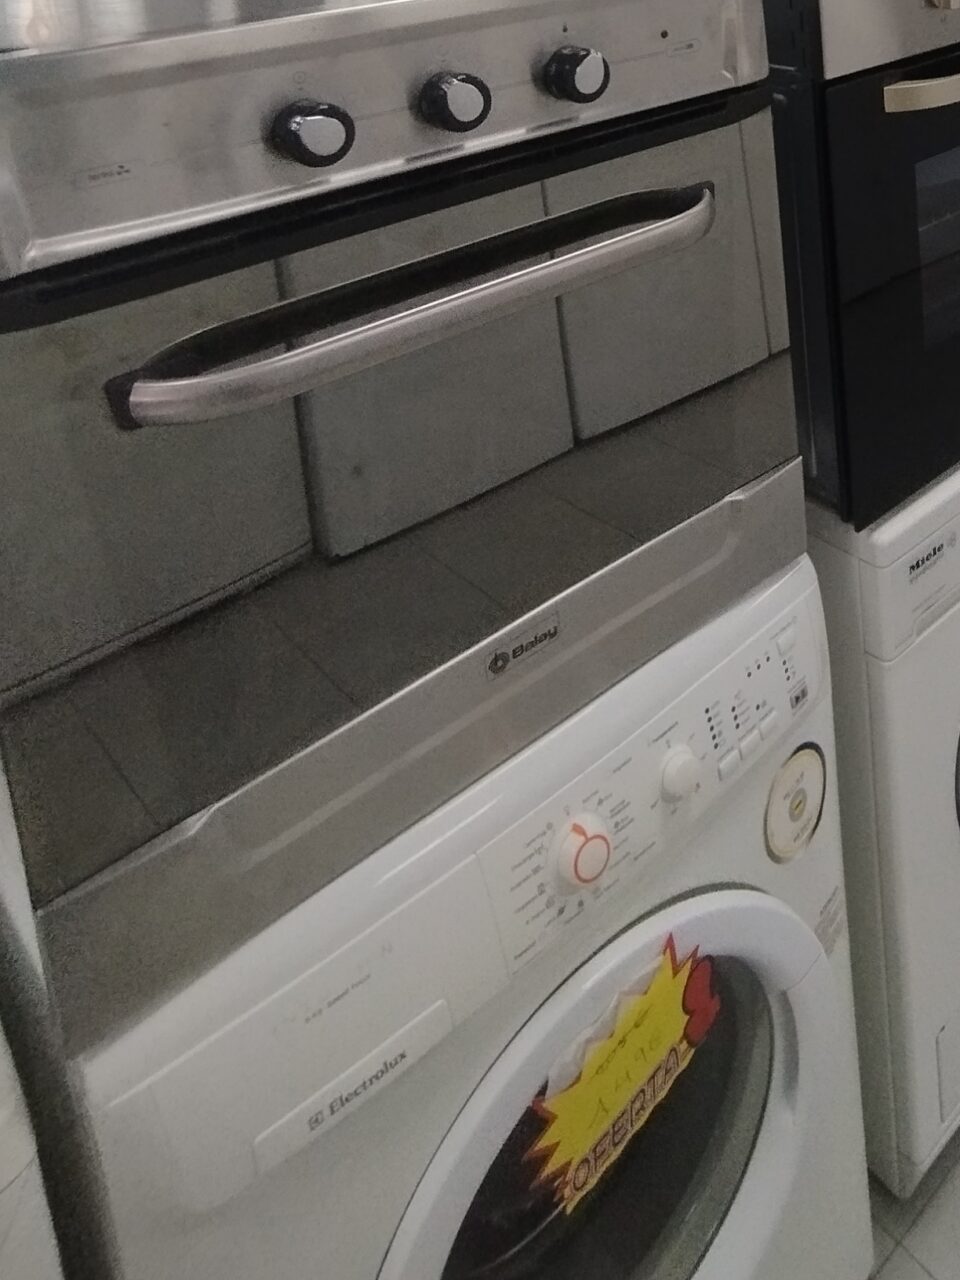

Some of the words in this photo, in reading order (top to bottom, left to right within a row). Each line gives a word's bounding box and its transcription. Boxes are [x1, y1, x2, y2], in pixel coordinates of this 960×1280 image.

[909, 543, 944, 575] Miele
[512, 626, 558, 659] Balay
[328, 1050, 408, 1117] Electrolux
[571, 1045, 682, 1194] OFERTA
